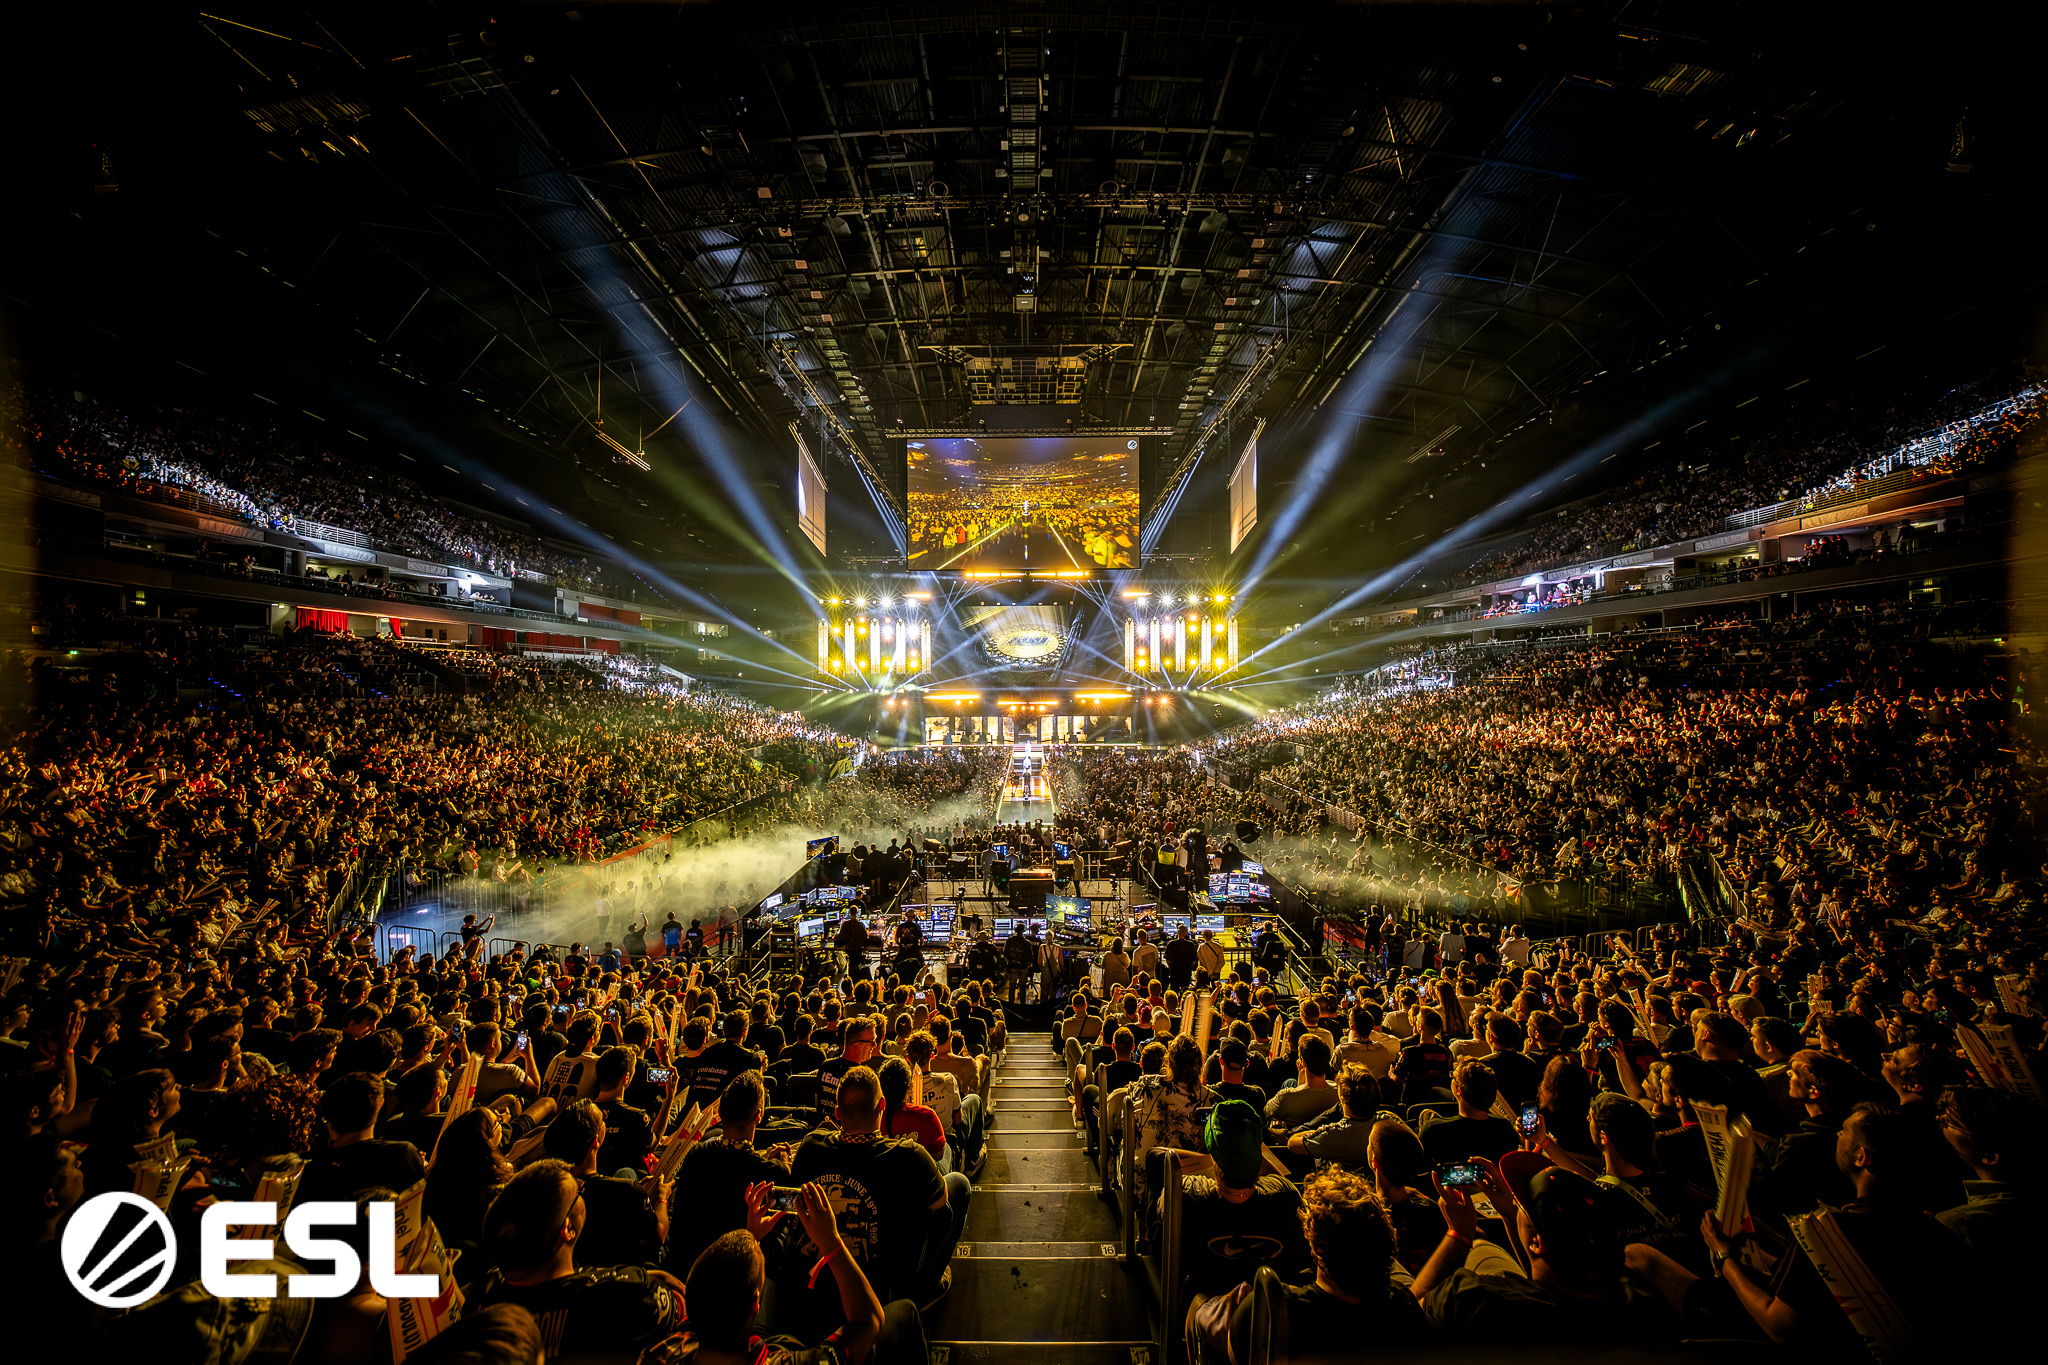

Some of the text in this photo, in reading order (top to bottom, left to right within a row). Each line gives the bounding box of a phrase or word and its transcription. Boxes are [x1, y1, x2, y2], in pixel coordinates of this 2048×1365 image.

[1996, 1046, 2027, 1080] CINEMA
[813, 1173, 843, 1184] TRIKE:
[845, 1177, 867, 1197] JUNE
[869, 1221, 878, 1244] 1999
[958, 1245, 1115, 1257] 16 16
[1794, 1224, 1814, 1253] intel
[933, 1350, 1147, 1365] 17 17
